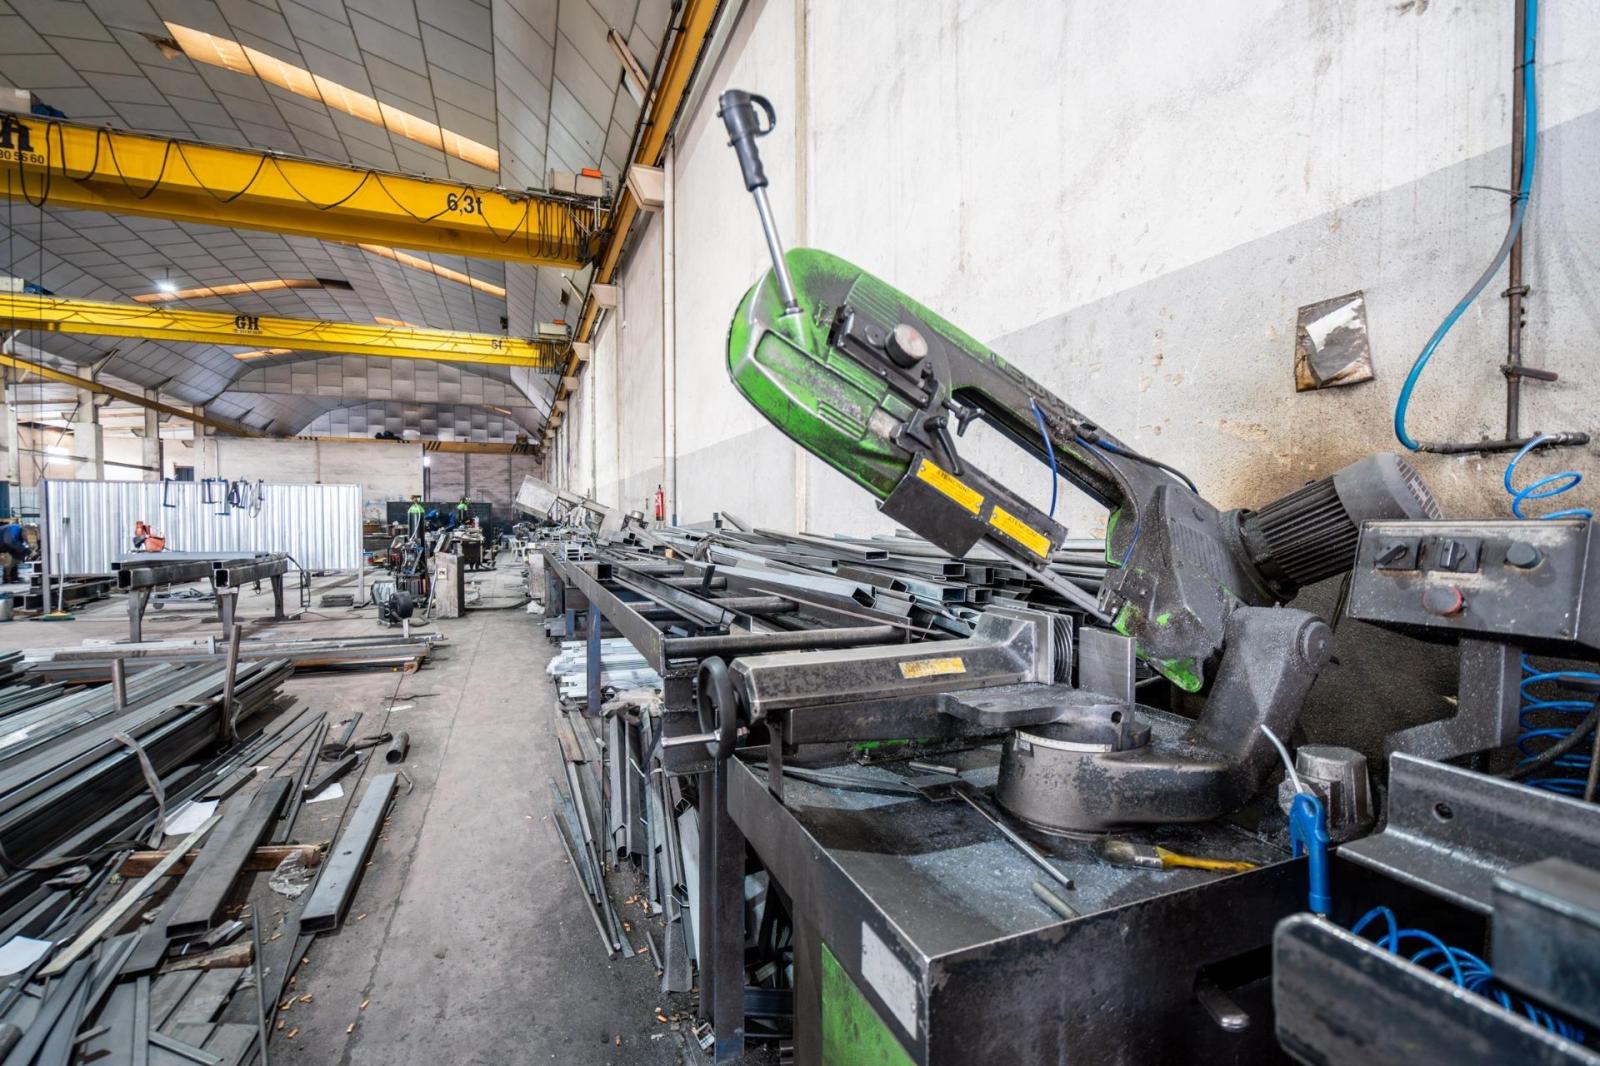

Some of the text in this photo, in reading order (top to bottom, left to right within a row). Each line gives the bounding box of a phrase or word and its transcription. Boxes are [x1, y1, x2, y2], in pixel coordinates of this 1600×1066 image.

[30, 154, 45, 164] 60
[447, 193, 482, 216] 6,3t
[235, 315, 259, 331] GH
